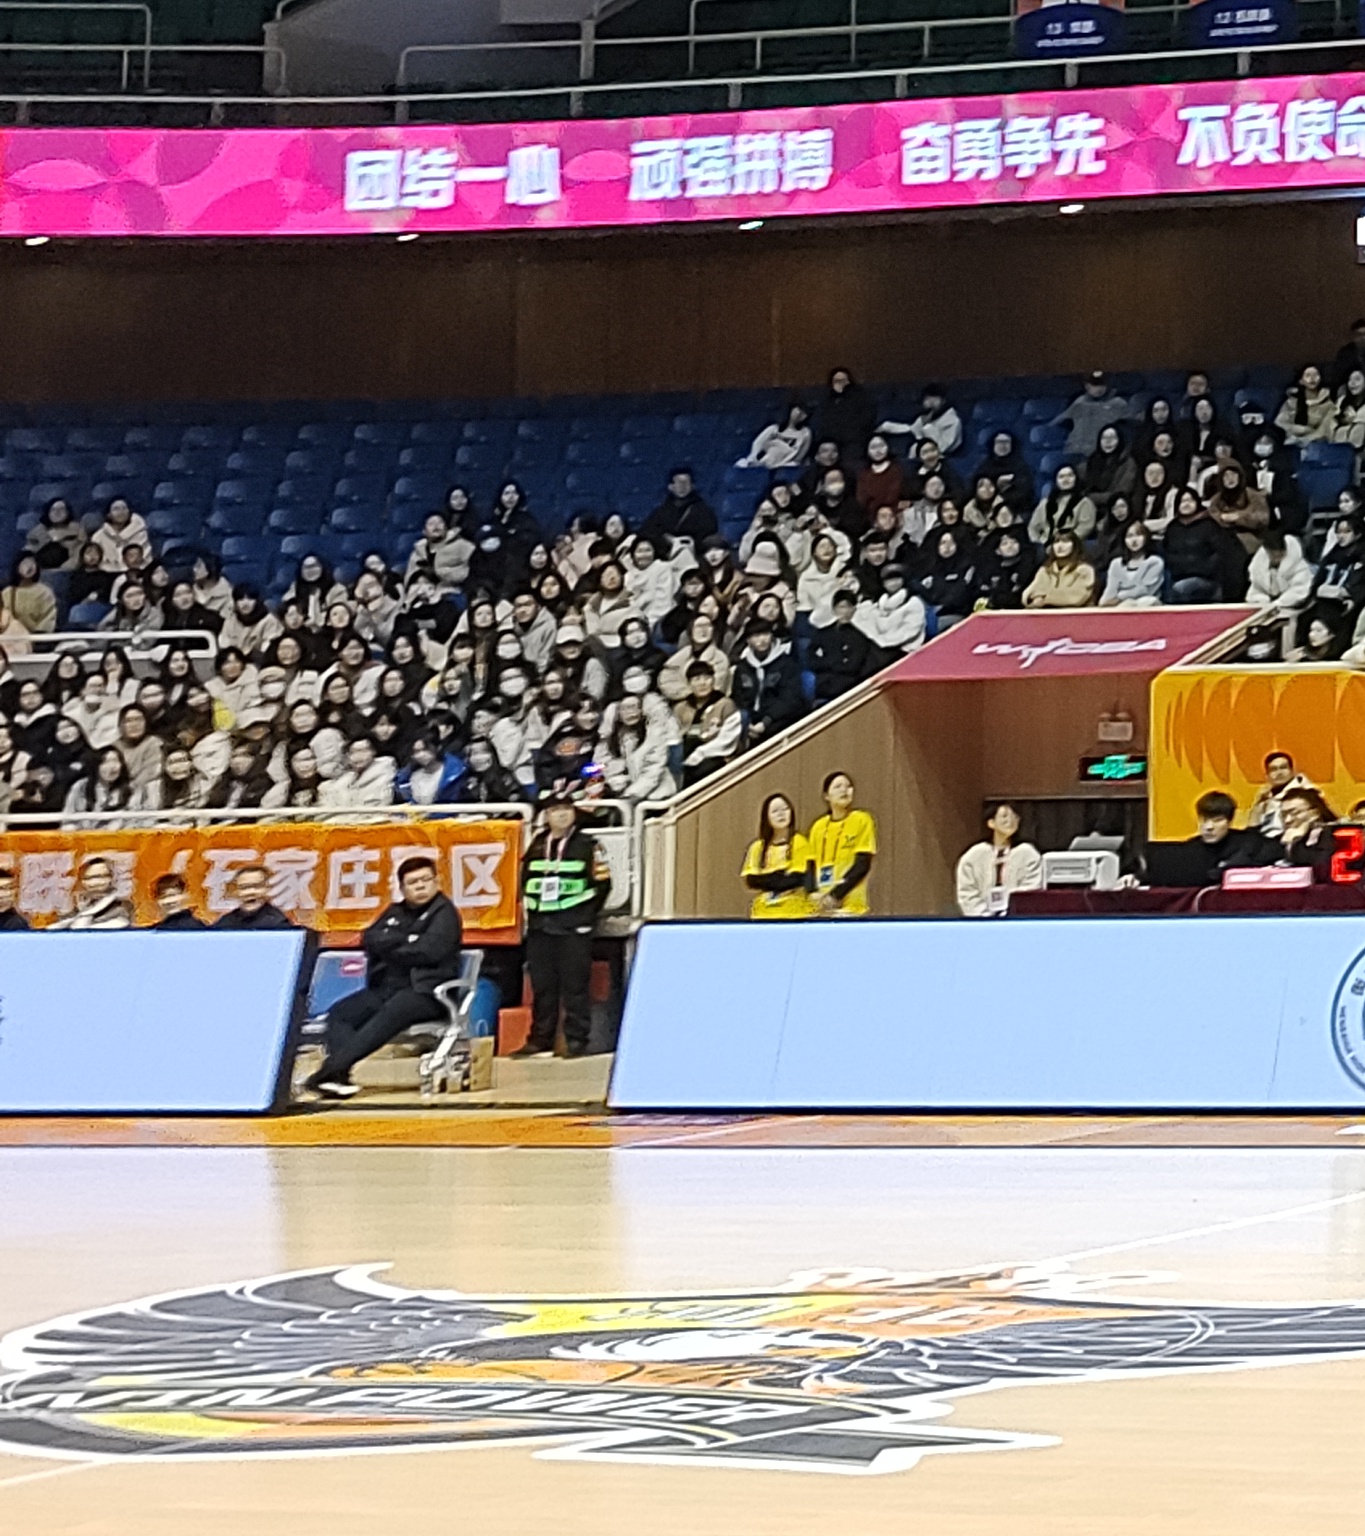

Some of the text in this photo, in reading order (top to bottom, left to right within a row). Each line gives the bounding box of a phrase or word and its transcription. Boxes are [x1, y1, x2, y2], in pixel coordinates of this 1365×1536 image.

[343, 144, 562, 212] 团结一心
[628, 130, 836, 201] 顽强拼搏
[899, 115, 1107, 185] 奋勇争先
[1330, 827, 1365, 882] 2
